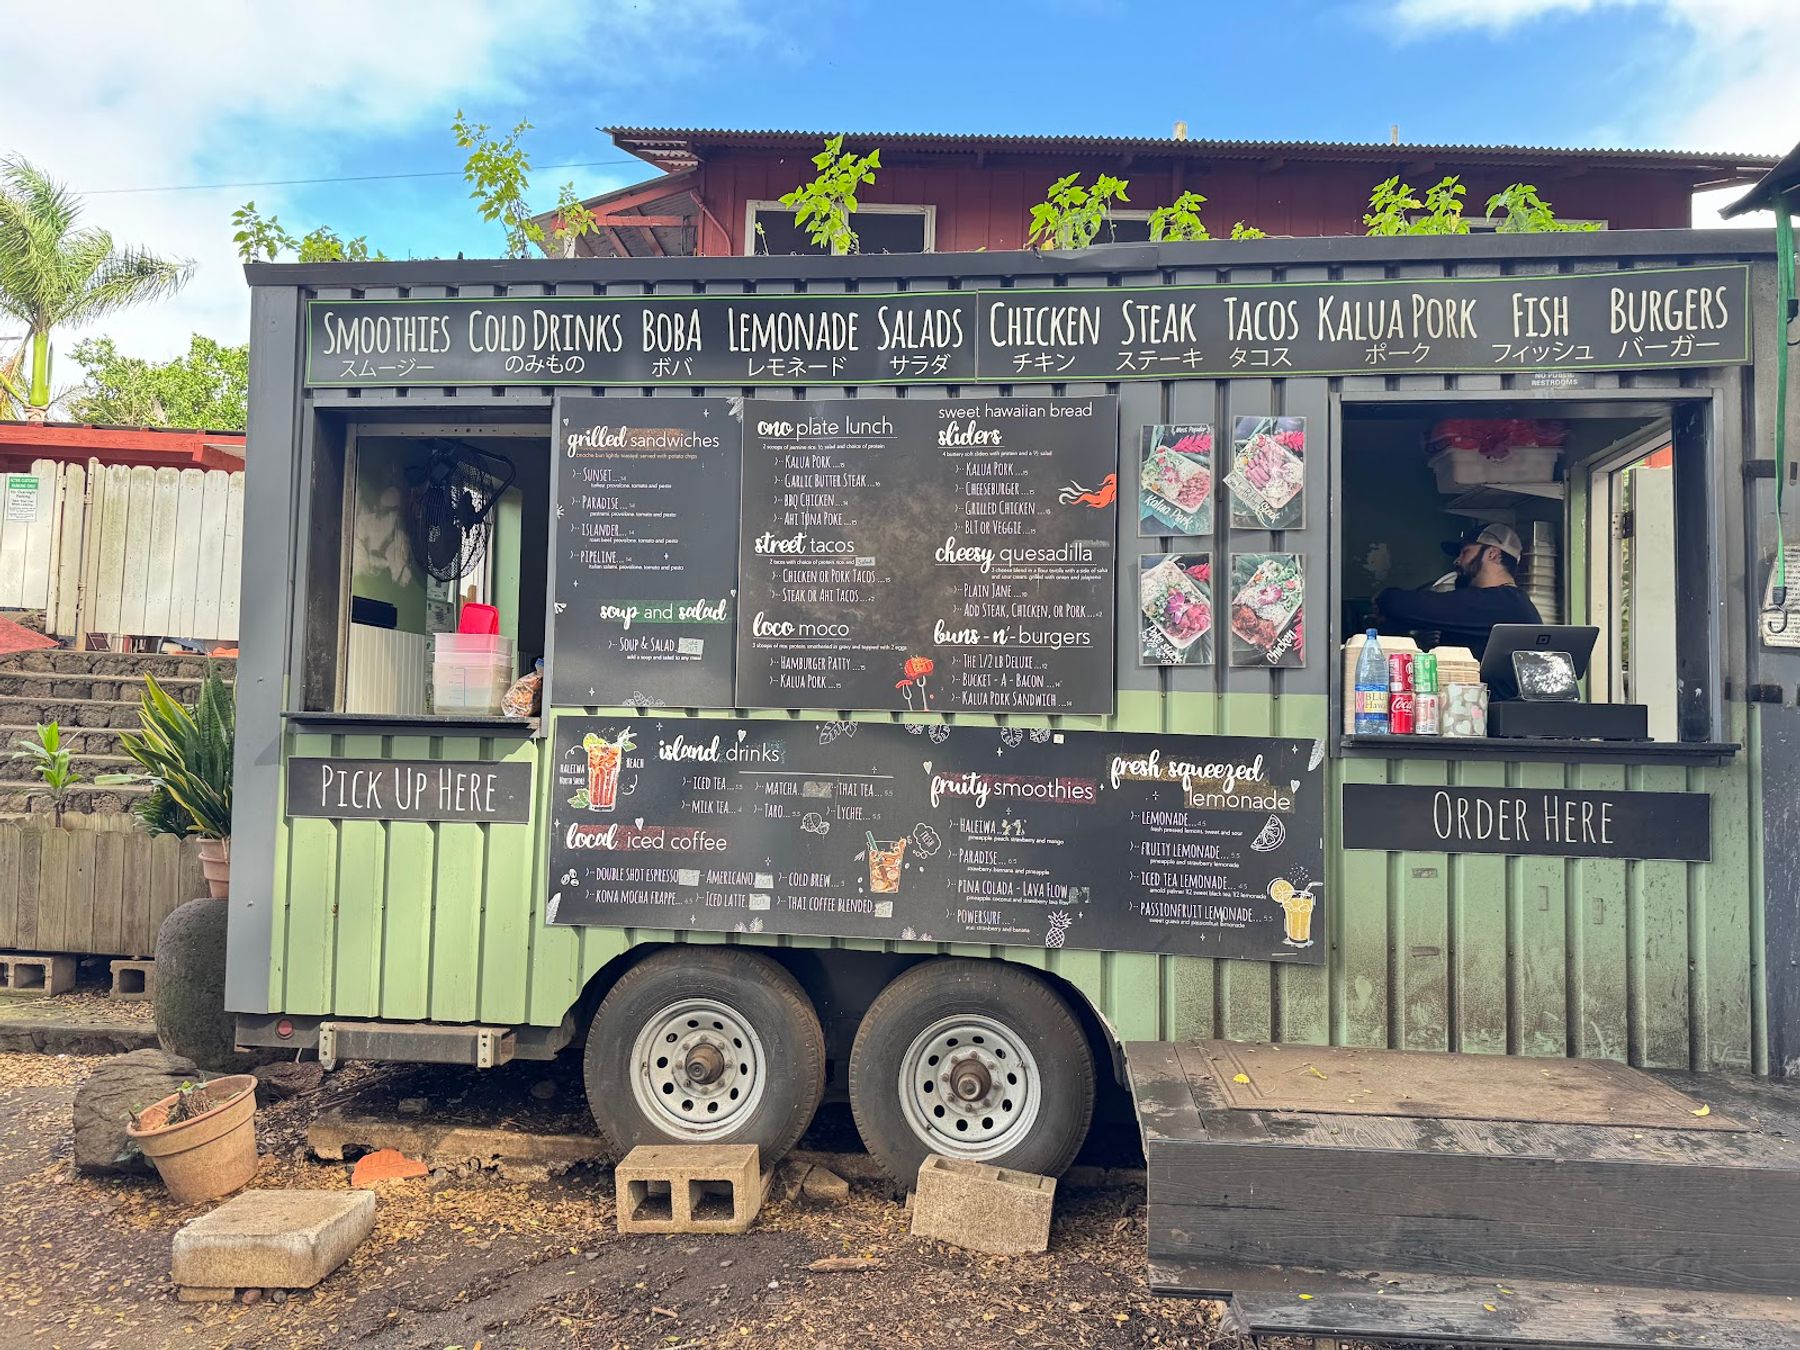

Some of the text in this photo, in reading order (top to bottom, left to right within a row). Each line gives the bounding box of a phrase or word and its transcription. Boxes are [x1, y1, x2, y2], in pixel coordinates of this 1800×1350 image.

[1223, 296, 1299, 341] TACOS
[1318, 294, 1477, 341] KALUA PORK
[1512, 292, 1569, 338] FISH
[1611, 285, 1728, 334] BURGERS
[642, 309, 701, 351] BOBA
[727, 307, 859, 352] LEMONADE
[877, 306, 963, 351] SALADS
[989, 302, 1100, 347] CHICKEN
[1121, 299, 1196, 344] STEAK
[323, 311, 451, 355] SMOOTHIES
[468, 310, 622, 353] COLD DRINKS
[1229, 347, 1292, 367] タコス
[1364, 343, 1431, 364] ポーク
[1492, 343, 1594, 363] フィッシュ
[1618, 337, 1719, 358] バーガー
[340, 359, 434, 377] スムージー
[505, 355, 585, 374] のみもの
[652, 358, 693, 376] ボバ
[748, 356, 846, 376] レモネード
[890, 354, 951, 375] サラダ
[1013, 353, 1075, 372] チキン
[1116, 350, 1203, 370] ステーキ
[939, 401, 1092, 418] sweet hawaiian bread
[757, 416, 892, 441] ono plate lunch
[938, 420, 1002, 446] sliders
[568, 426, 719, 458] grilled sandwiches
[785, 455, 831, 468] KALUA PORK
[583, 467, 612, 482] SUNSET
[784, 473, 866, 488] GARLIC BUTTER STEAK
[965, 482, 1019, 495] CHEESEBURGER
[583, 495, 619, 509] PARADISE
[784, 493, 835, 509] BBQ CHICKEN
[965, 501, 1036, 515] GRILLED CHICKEN
[784, 512, 842, 525] AHI TUNA POKE
[965, 520, 1021, 534] BLT OR VEGGIE
[582, 523, 619, 536] ISLANDER
[755, 532, 855, 554] street tacos
[581, 550, 617, 563] PIPELINE
[935, 536, 1092, 573] cheesy quesadilla
[782, 569, 875, 582] CHICKEN PORK TACOS
[783, 588, 859, 602] STEAK AHI TACOS
[964, 583, 1012, 598] PLAIN JANE
[600, 599, 727, 630] soup and salad
[964, 603, 979, 617] ADD
[1066, 603, 1086, 617] PORK
[753, 612, 849, 637] loco moco
[620, 637, 675, 651] SOUP SALAD
[1019, 625, 1090, 650] burgers
[1266, 629, 1296, 664] Chicken
[780, 656, 850, 671] HAMBURGER PATTY
[963, 654, 1033, 669] THE 1/2 LB DELUXE
[962, 673, 1044, 687] BUCKET BACON
[962, 690, 1057, 707] KALUA PORK SANDWICH
[659, 735, 780, 762] island drinks
[1111, 749, 1264, 794] fresh squeezed
[322, 764, 497, 812] PICK UP HERE
[693, 776, 726, 790] ICED TEA
[765, 782, 797, 796] MATCHA
[839, 782, 857, 796] THAI
[860, 783, 874, 797] TEA
[931, 772, 1093, 808] fruity smoothies
[692, 800, 729, 815] MILK TEA
[1188, 786, 1291, 811] lemonade
[764, 803, 784, 818] TARO
[837, 805, 863, 821] LYCHEE
[1141, 811, 1188, 826] LEMONADE
[1433, 791, 1614, 844] ORDER HERE
[960, 818, 996, 834] HALEIWA
[566, 823, 727, 850] local iced coffee
[959, 848, 998, 865] PARADISE
[1141, 841, 1220, 860] FRUITY LEMONADE
[596, 867, 624, 881] DOUBLE
[626, 868, 644, 882] SHOT
[646, 868, 679, 883] ESPRESSO
[707, 870, 753, 886] AMERICANO
[788, 873, 807, 887] COLD
[810, 873, 831, 887] BREW
[1141, 871, 1227, 890] ICED TEA LEMONADE
[596, 890, 676, 905] KONA MOCHA FRAPPE
[958, 879, 979, 894] PINA
[982, 880, 1013, 895] COLADA
[1023, 881, 1044, 897] LAVA
[1048, 883, 1068, 898] FLOW
[705, 891, 722, 907] ICED
[724, 893, 746, 907] LATTE
[788, 895, 806, 911] THAI
[809, 897, 835, 912] COFFEE
[837, 899, 872, 913] BLENDED
[957, 909, 1001, 925] POWERSURF
[1140, 901, 1252, 923] PASSIONFRUIT LEMONADE
